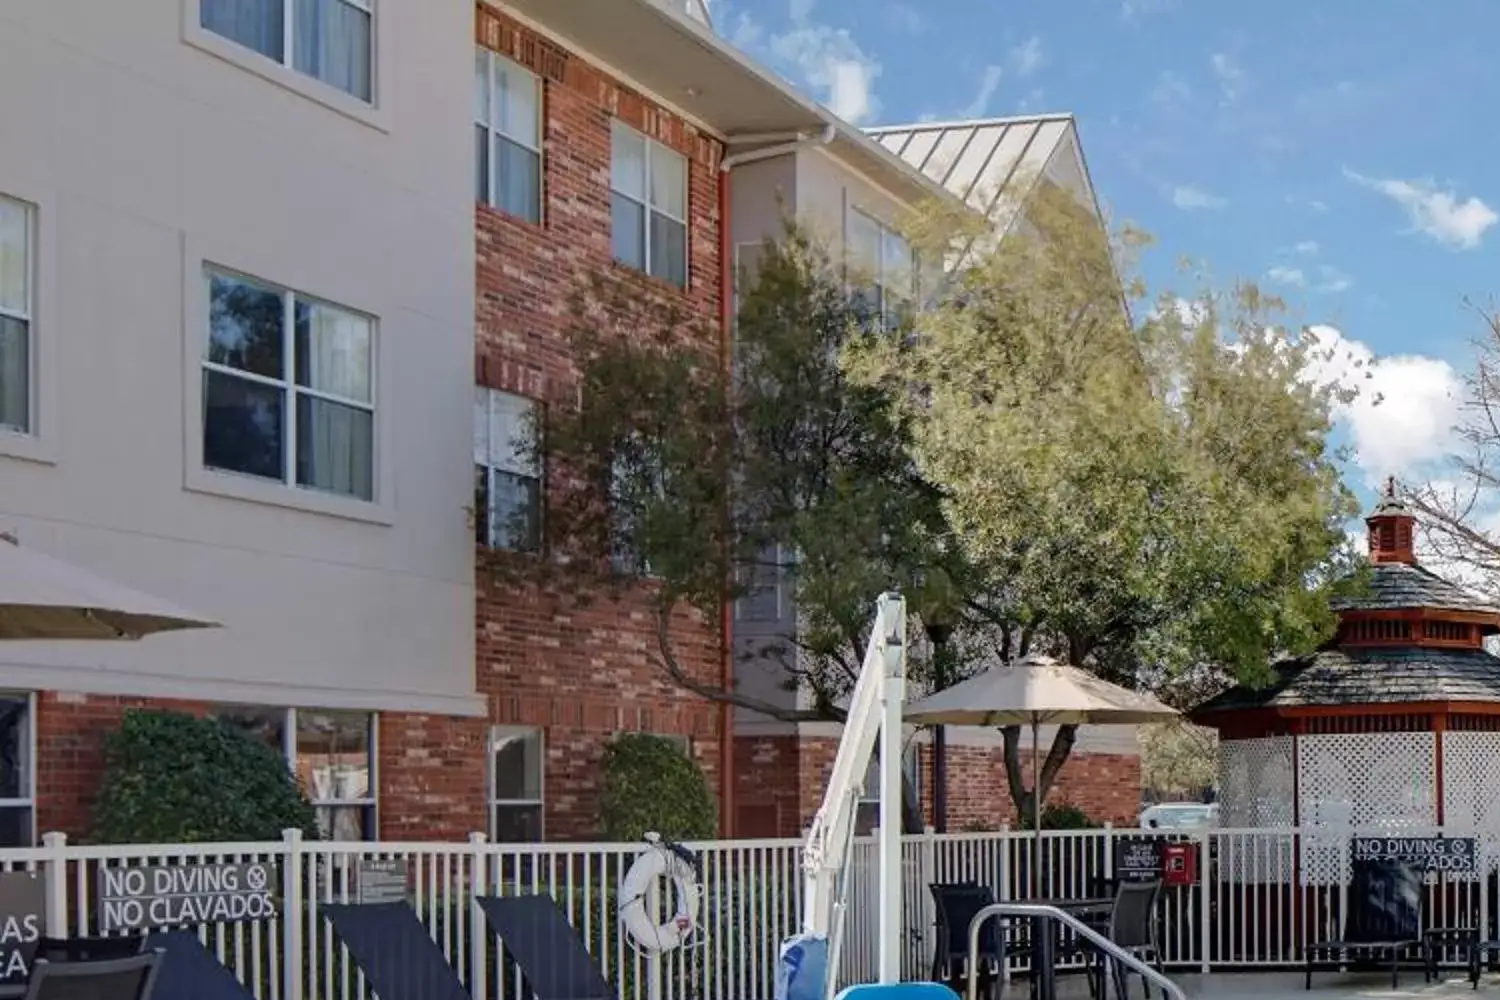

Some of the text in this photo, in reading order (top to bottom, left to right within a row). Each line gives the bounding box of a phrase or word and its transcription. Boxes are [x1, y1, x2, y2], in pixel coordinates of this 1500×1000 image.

[1356, 839, 1445, 854] NO DIVING
[105, 866, 239, 897] NO DIVING
[104, 893, 276, 927] NO CLAVADOS
